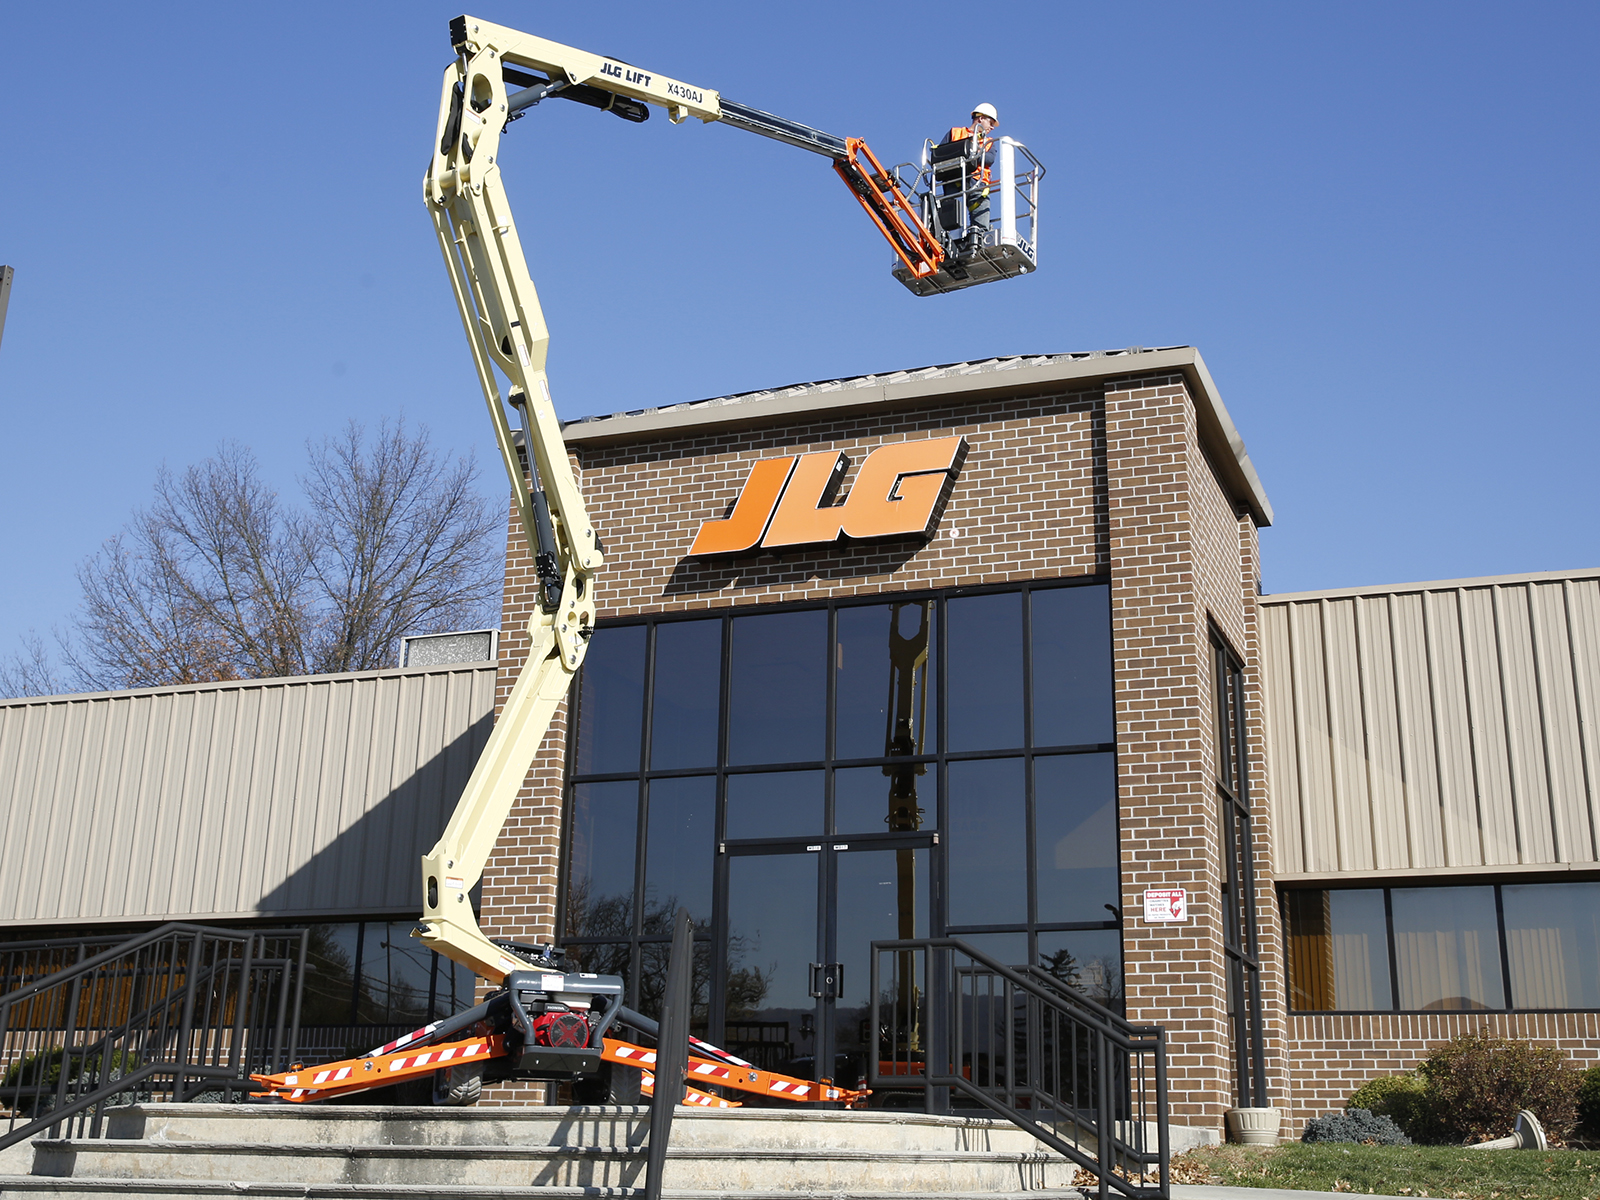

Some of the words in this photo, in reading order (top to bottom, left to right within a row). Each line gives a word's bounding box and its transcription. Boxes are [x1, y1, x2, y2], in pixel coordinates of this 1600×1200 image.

[600, 62, 622, 78] JLG
[625, 69, 651, 87] LIFT
[667, 82, 703, 103] X430AJ
[1017, 239, 1034, 259] JLG
[688, 435, 965, 557] JLG
